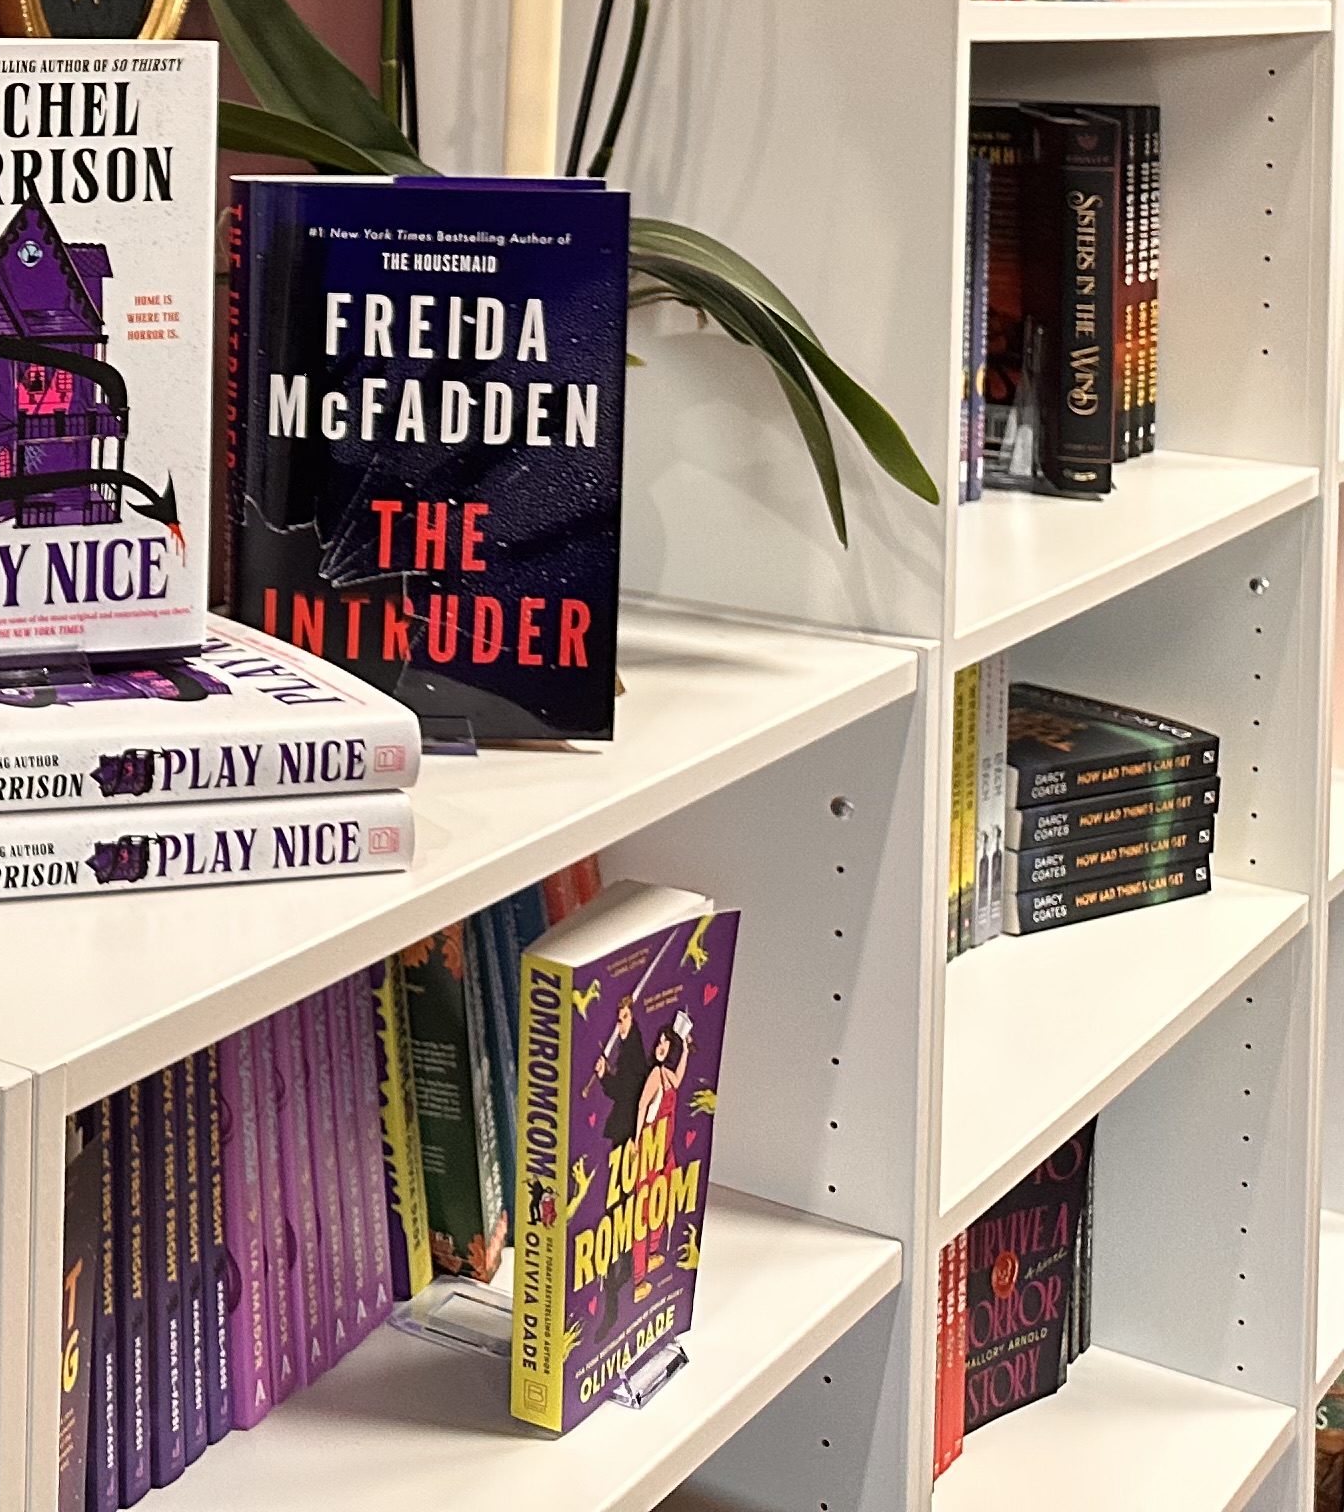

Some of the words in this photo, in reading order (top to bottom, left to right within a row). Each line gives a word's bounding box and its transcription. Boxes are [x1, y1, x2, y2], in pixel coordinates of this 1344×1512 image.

[40, 59, 89, 74] AUTHOR
[93, 59, 108, 73] OF
[111, 58, 127, 73] SO
[131, 58, 184, 73] THIRSTY
[308, 227, 323, 238] #1
[329, 228, 358, 239] New
[363, 228, 392, 240] York
[397, 229, 433, 242] Times
[436, 230, 506, 247] Bestselling
[509, 233, 553, 245] Author
[557, 233, 572, 245] of
[1066, 190, 1103, 270] SISTERS
[382, 252, 409, 271] THE
[414, 253, 500, 273] HOUSEMAID
[1075, 276, 1095, 296] IN
[325, 292, 548, 363] FREIDA
[1075, 304, 1095, 338] THE
[268, 373, 598, 448] McFADDEN
[371, 500, 490, 572] THE
[44, 536, 169, 606] NICE
[263, 588, 592, 669] INTRUDER
[14, 755, 60, 769] AUTHOR
[161, 744, 263, 791] PLAY
[277, 739, 367, 785] NICE
[1077, 769, 1100, 785] HOW
[1153, 757, 1171, 773] CAN
[1030, 783, 1067, 799] COATES
[1035, 772, 1066, 786] DARCY
[1037, 814, 1068, 828] DARCY
[1079, 811, 1102, 827] HOW
[1155, 799, 1173, 814] CAN
[1033, 823, 1070, 842] COATES
[10, 843, 55, 858] AUTHOR
[156, 828, 257, 877] PLAY
[272, 821, 361, 869] NICE
[1034, 855, 1064, 869] DARCY
[1076, 851, 1099, 868] HOW
[1151, 838, 1169, 854] CAN
[1032, 865, 1067, 883] COATES
[1034, 894, 1063, 908] DARCY
[1075, 891, 1098, 907] HOW
[1149, 878, 1167, 893] CAN
[1032, 905, 1067, 924] COATES
[525, 969, 562, 1185] ZOMROMCOM
[606, 1120, 667, 1210] ZOM
[573, 1159, 702, 1292] ROMCOM
[968, 1204, 1044, 1271] URVIVE
[1051, 1202, 1068, 1247] A
[524, 1231, 541, 1304] OLIVIA
[966, 1275, 1062, 1354] ORROR
[522, 1309, 539, 1372] DADE
[580, 1342, 632, 1403] OLIVIA
[636, 1304, 676, 1355] DADE
[1008, 1327, 1048, 1351] ARNOLD
[967, 1348, 1041, 1423] STORY
